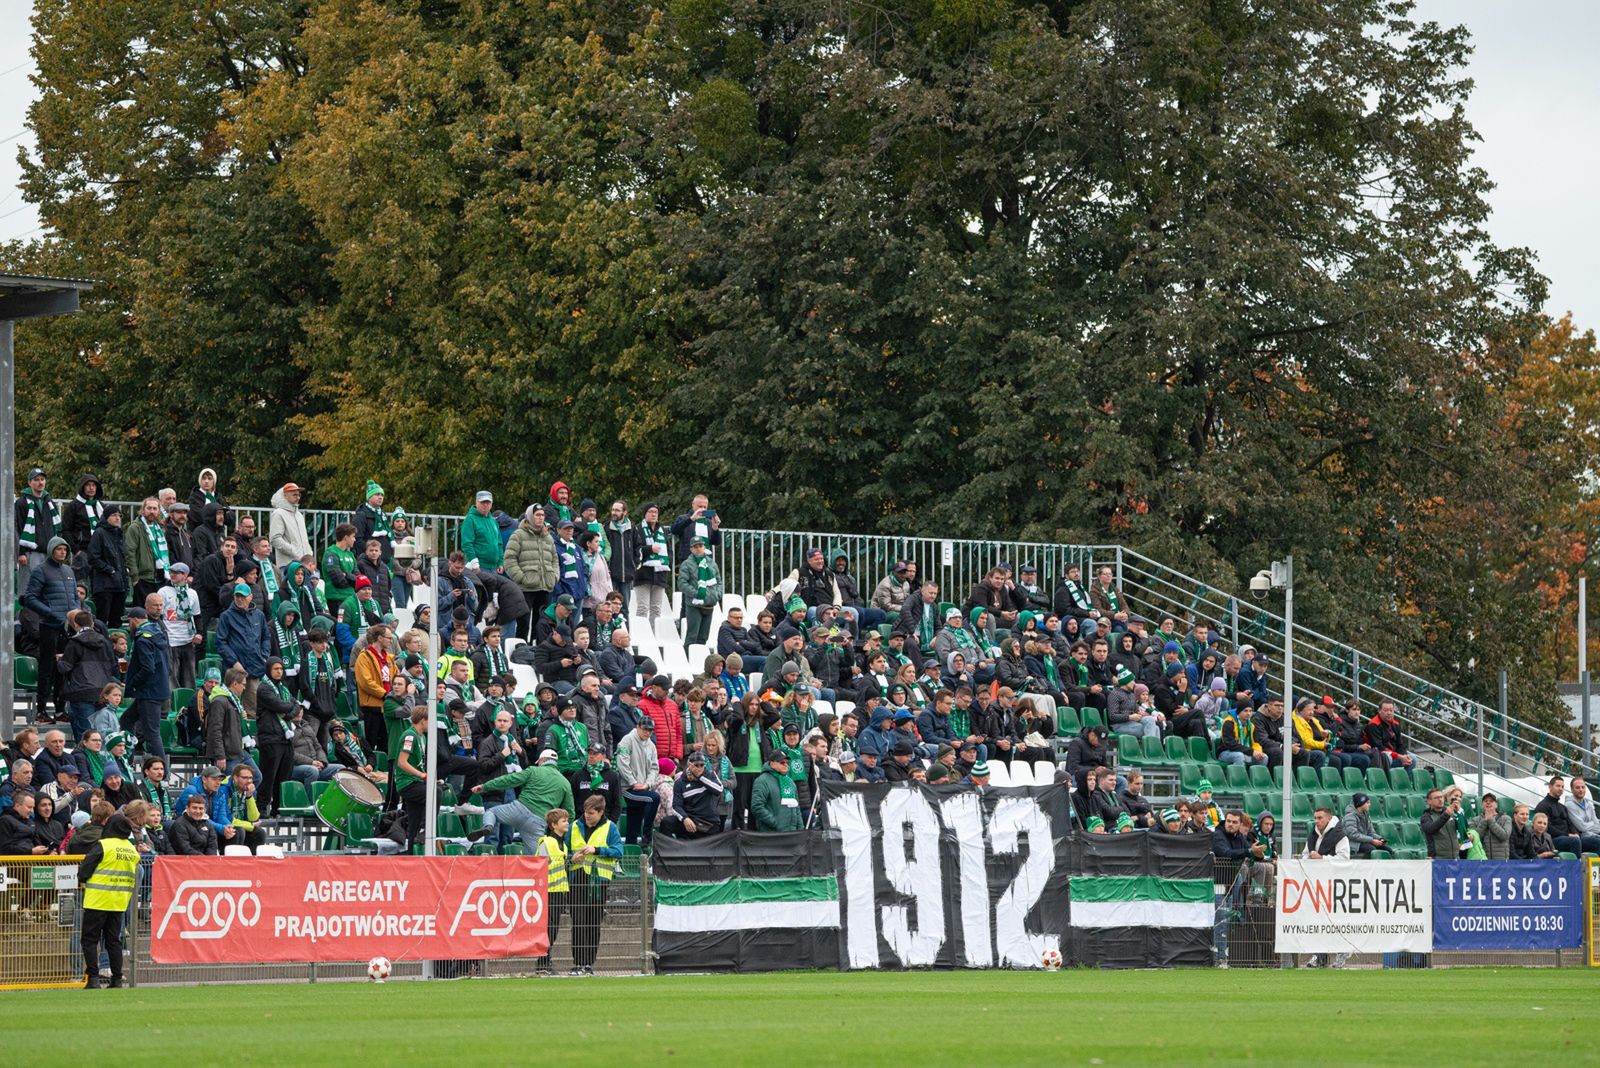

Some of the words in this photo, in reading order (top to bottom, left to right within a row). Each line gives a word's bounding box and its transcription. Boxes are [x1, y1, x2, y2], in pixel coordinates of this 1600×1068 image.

[826, 786, 1062, 969] 1912
[1592, 871, 1597, 880] 9
[303, 880, 409, 902] AGREGATY
[1445, 877, 1567, 901] TELESKOP
[274, 910, 436, 943] PRĄDOTWÓRCZE
[1282, 924, 1319, 935] WYNAJEM
[1321, 922, 1374, 935] PODNOŚNIKÓW
[1376, 924, 1379, 934] I
[1381, 922, 1424, 934] RUSZTOWAŃ
[1452, 916, 1519, 932] CODZIENNIE
[1522, 916, 1531, 931] O
[1534, 915, 1564, 931] 18:30
